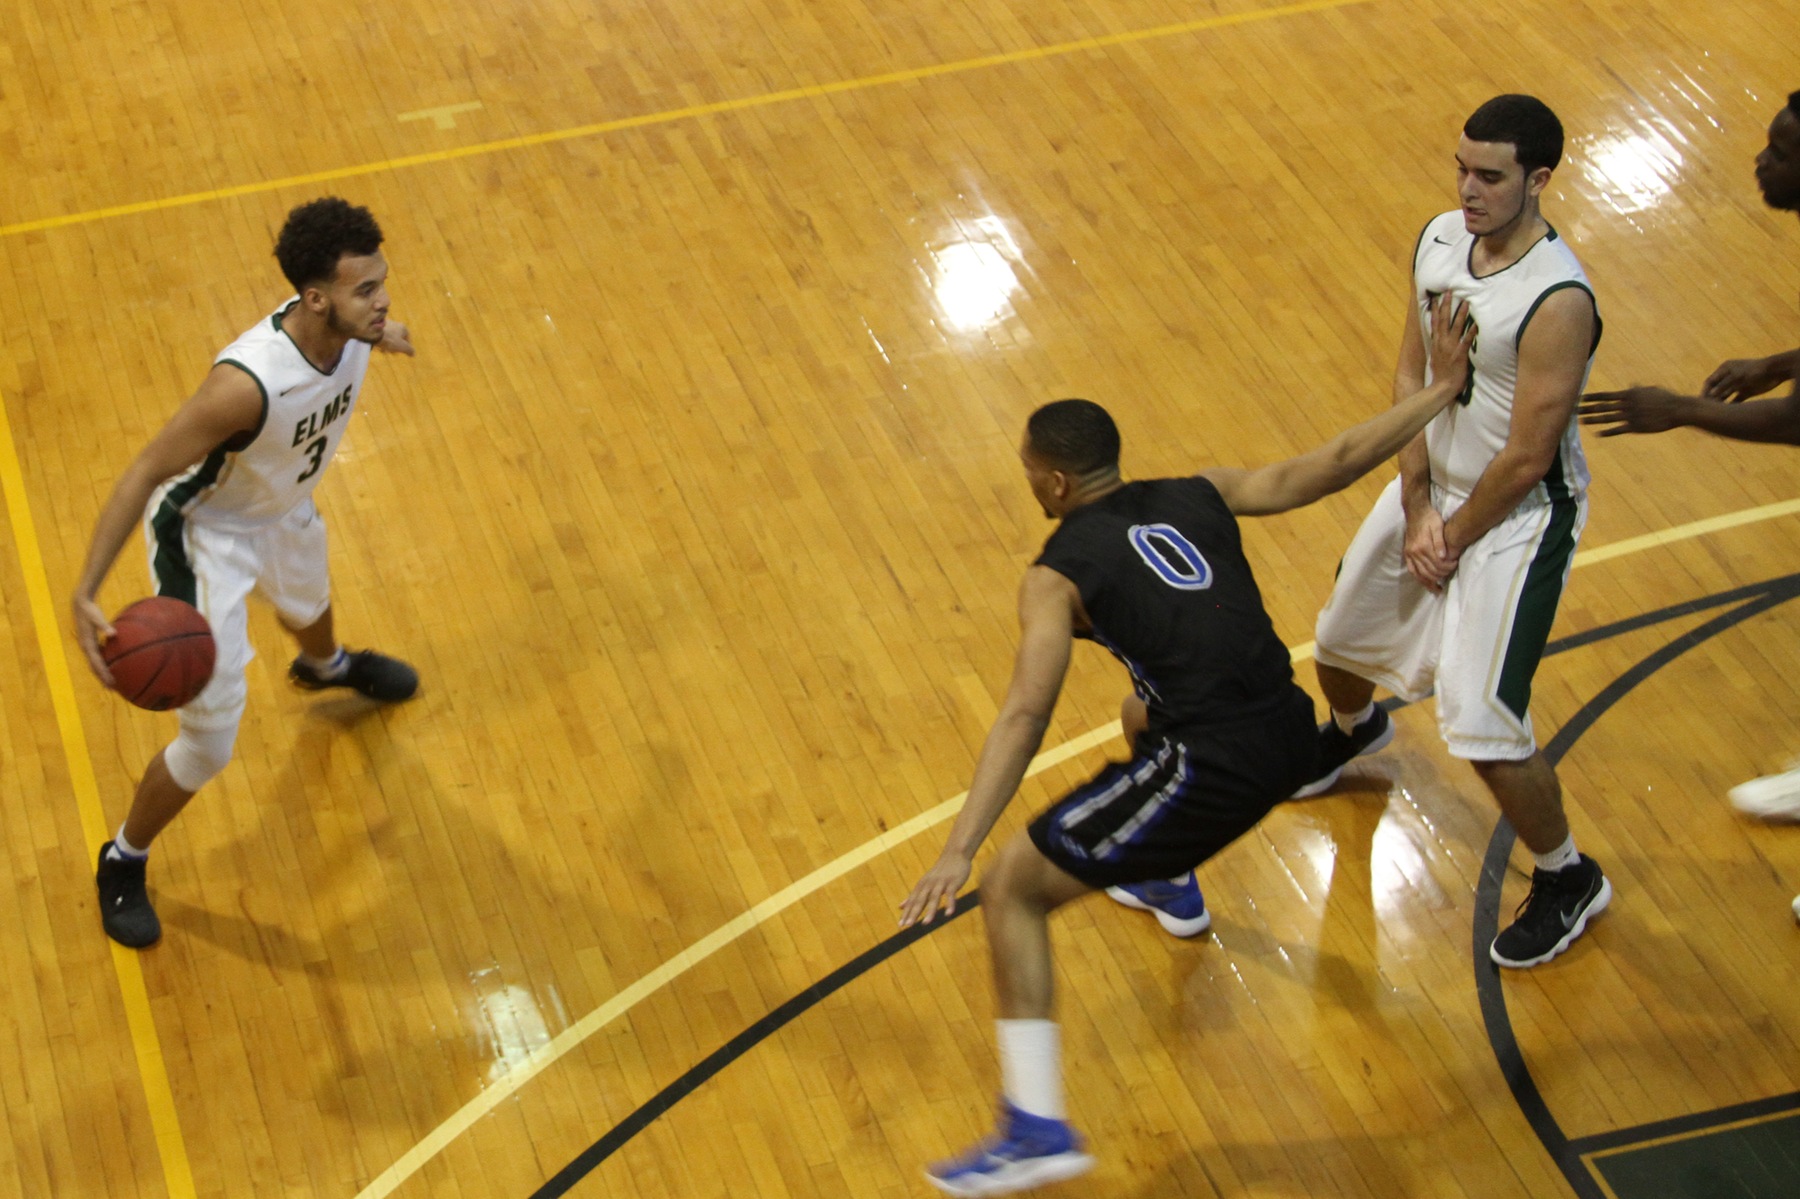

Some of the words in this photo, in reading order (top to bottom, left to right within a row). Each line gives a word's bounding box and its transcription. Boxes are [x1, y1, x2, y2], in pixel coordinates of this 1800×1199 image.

[291, 383, 353, 449] ELMS
[296, 435, 328, 484] 3
[1127, 522, 1213, 591] 0
